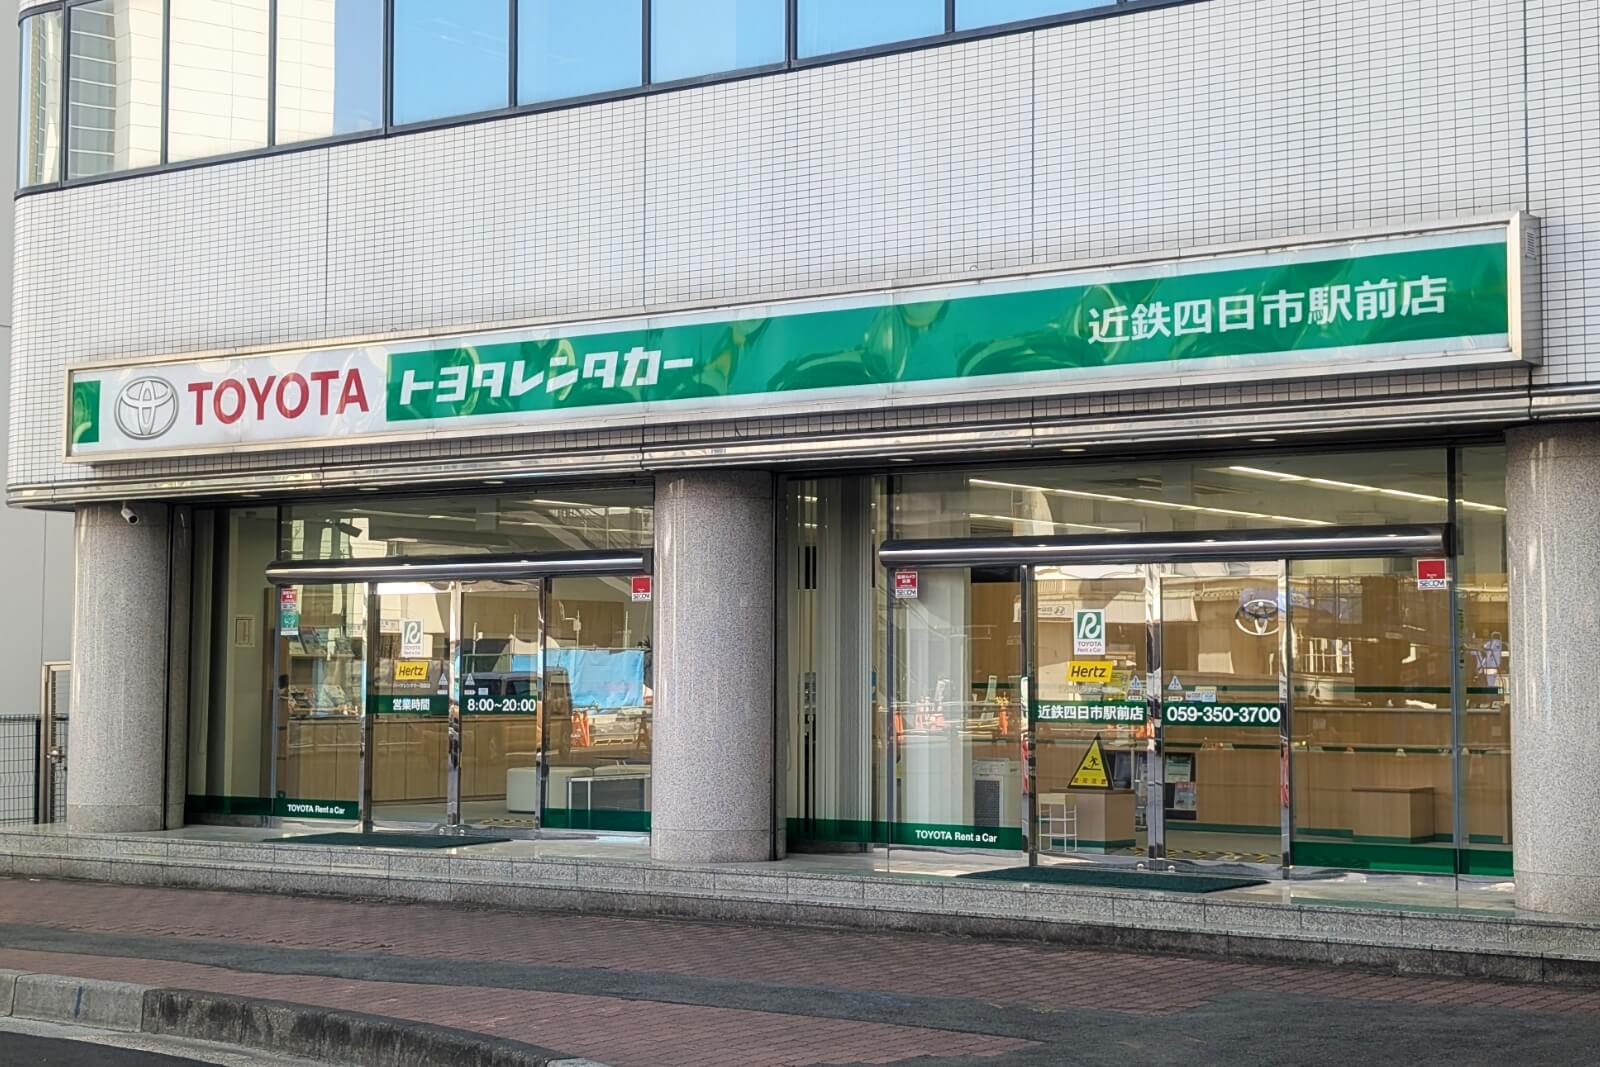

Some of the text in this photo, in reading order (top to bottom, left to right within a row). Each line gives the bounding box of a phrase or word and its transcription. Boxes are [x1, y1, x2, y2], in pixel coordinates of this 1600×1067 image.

[1088, 275, 1448, 345] 近鉄四日市駅前店
[400, 346, 694, 406] トヨタレンタカー
[188, 367, 370, 426] TOYOTA
[398, 666, 424, 677] Hertz
[1070, 665, 1107, 678] Hertz
[393, 698, 430, 711] 営業時間
[1038, 704, 1144, 720] 近鉄四日市駅前店
[1166, 706, 1281, 723] 059-350-3700
[287, 804, 314, 813] TOYOTA
[314, 805, 329, 814] Rent
[334, 806, 346, 815] Car
[915, 830, 997, 843] TOYOTA Rent a Car
